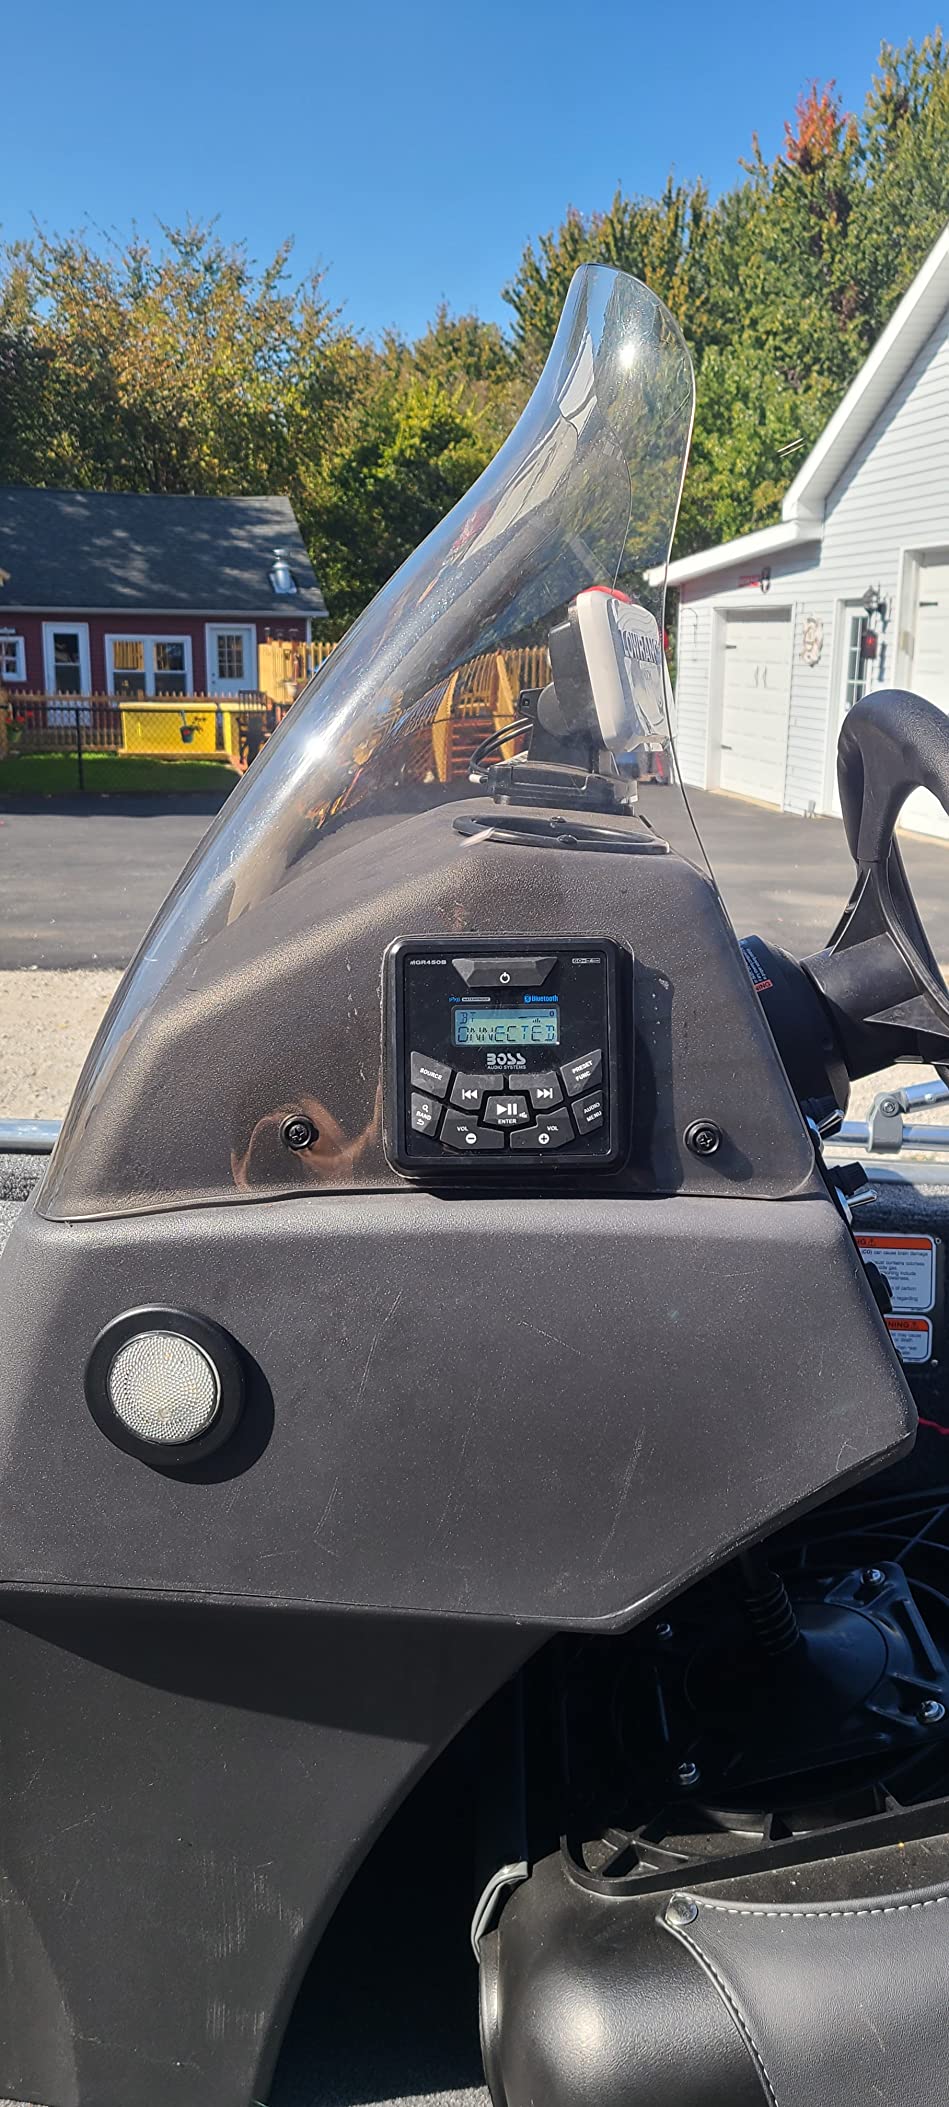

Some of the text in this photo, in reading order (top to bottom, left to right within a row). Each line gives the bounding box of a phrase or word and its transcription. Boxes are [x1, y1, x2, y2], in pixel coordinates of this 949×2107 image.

[487, 1053, 526, 1066] BOSS
[572, 1060, 593, 1074] PRESET
[420, 1067, 442, 1080] SOURCE
[576, 1070, 591, 1081] FUNC
[583, 1102, 601, 1114] AUDIO
[416, 1110, 432, 1121] BAND
[586, 1110, 602, 1122] MENU
